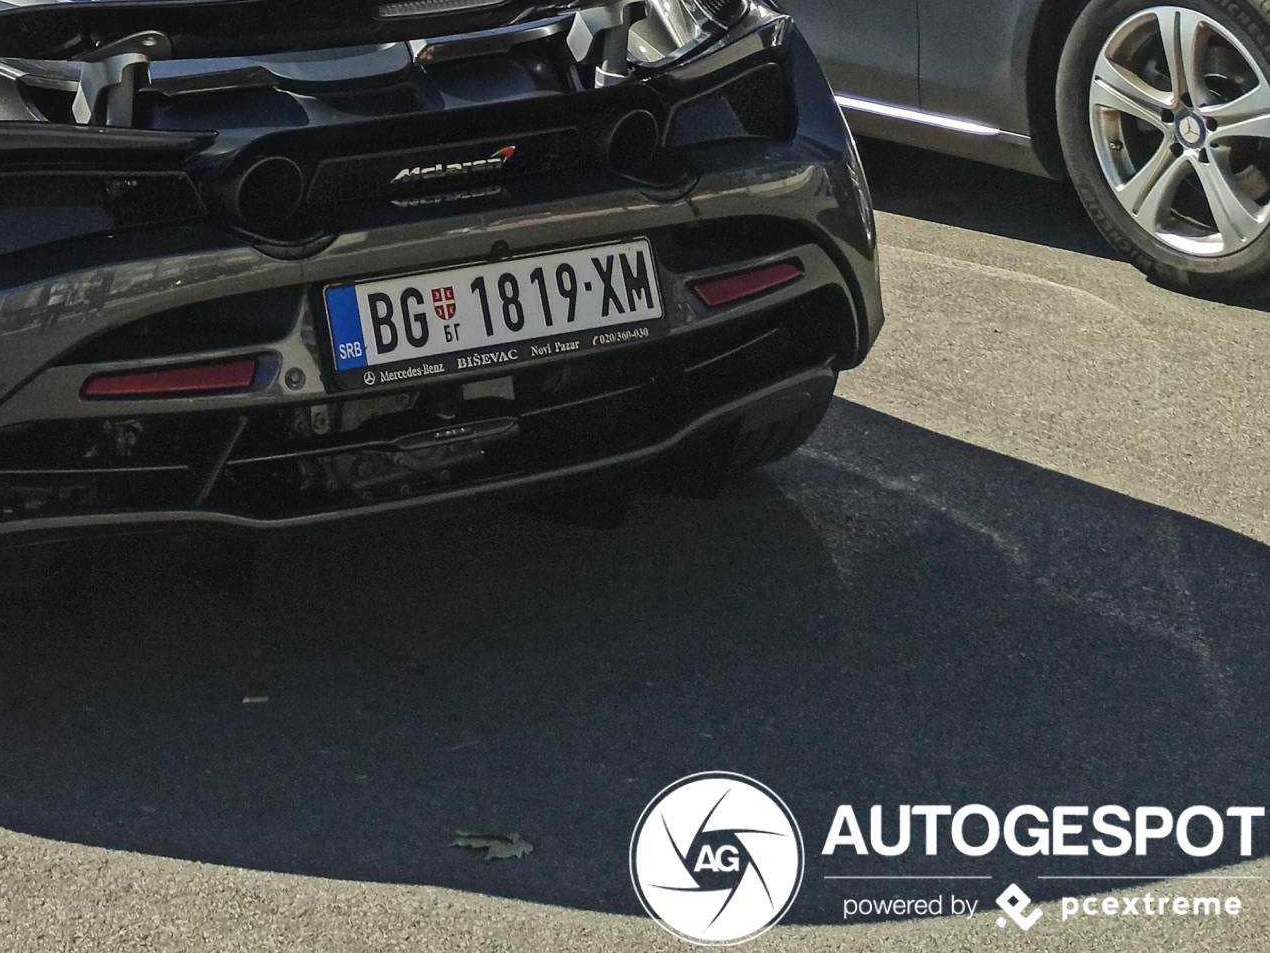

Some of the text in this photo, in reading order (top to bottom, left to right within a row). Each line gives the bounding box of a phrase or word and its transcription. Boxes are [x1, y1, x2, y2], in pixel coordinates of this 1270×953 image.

[390, 158, 503, 184] McLaren
[368, 287, 430, 355] BG
[339, 341, 362, 360] SRB
[379, 327, 649, 382] Mercedes-Benz BIŠEVAC Novi Pazar 020/360-030
